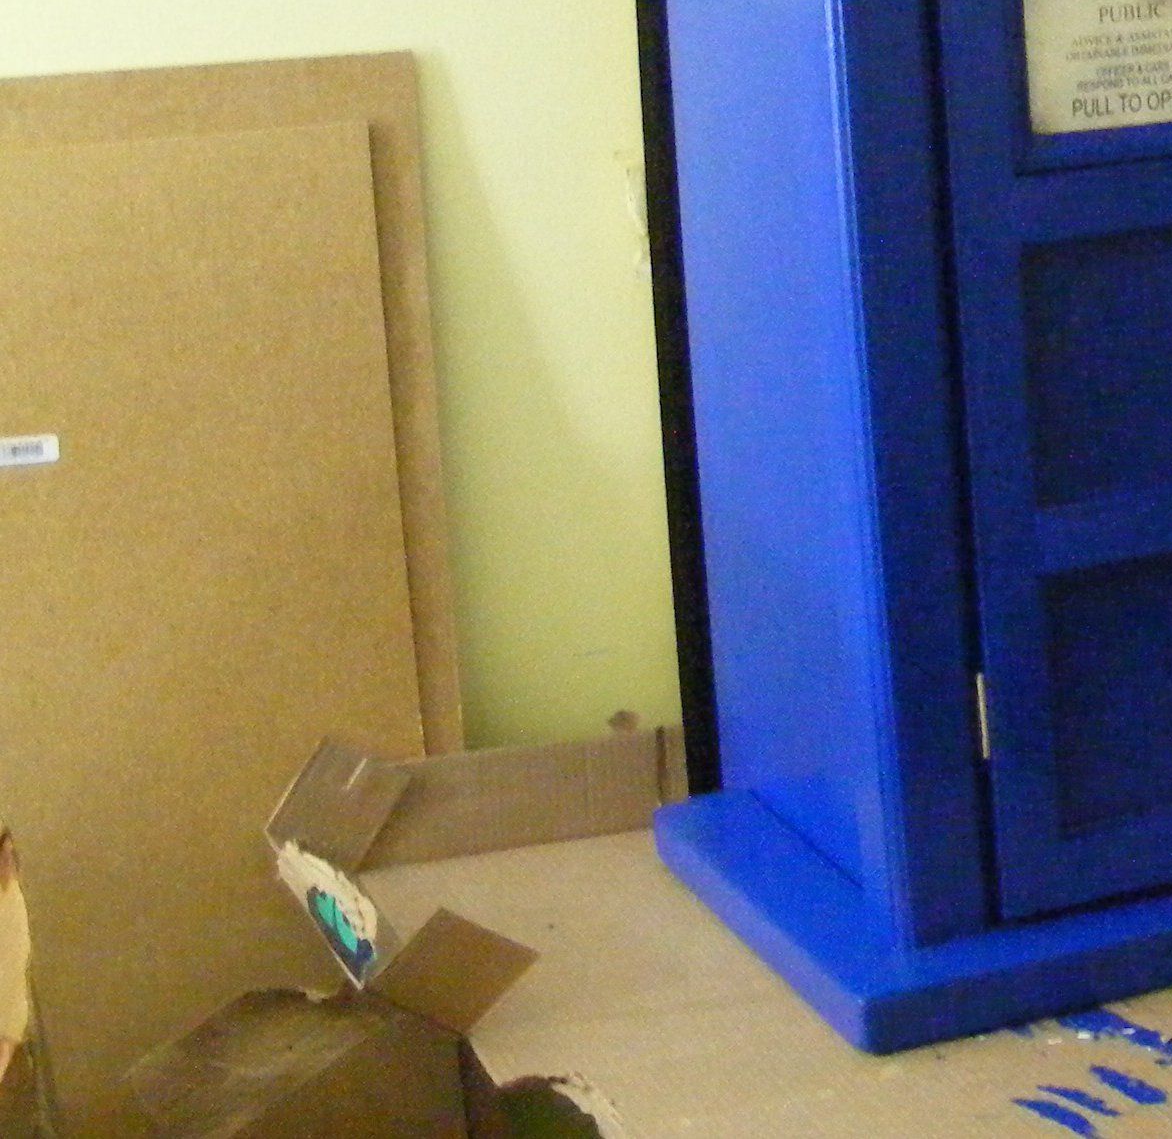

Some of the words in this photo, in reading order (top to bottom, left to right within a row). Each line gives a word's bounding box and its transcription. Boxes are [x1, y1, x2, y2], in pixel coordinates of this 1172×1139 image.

[1099, 4, 1163, 23] PUBLIC
[1072, 98, 1113, 118] PULL
[1119, 93, 1142, 113] TO
